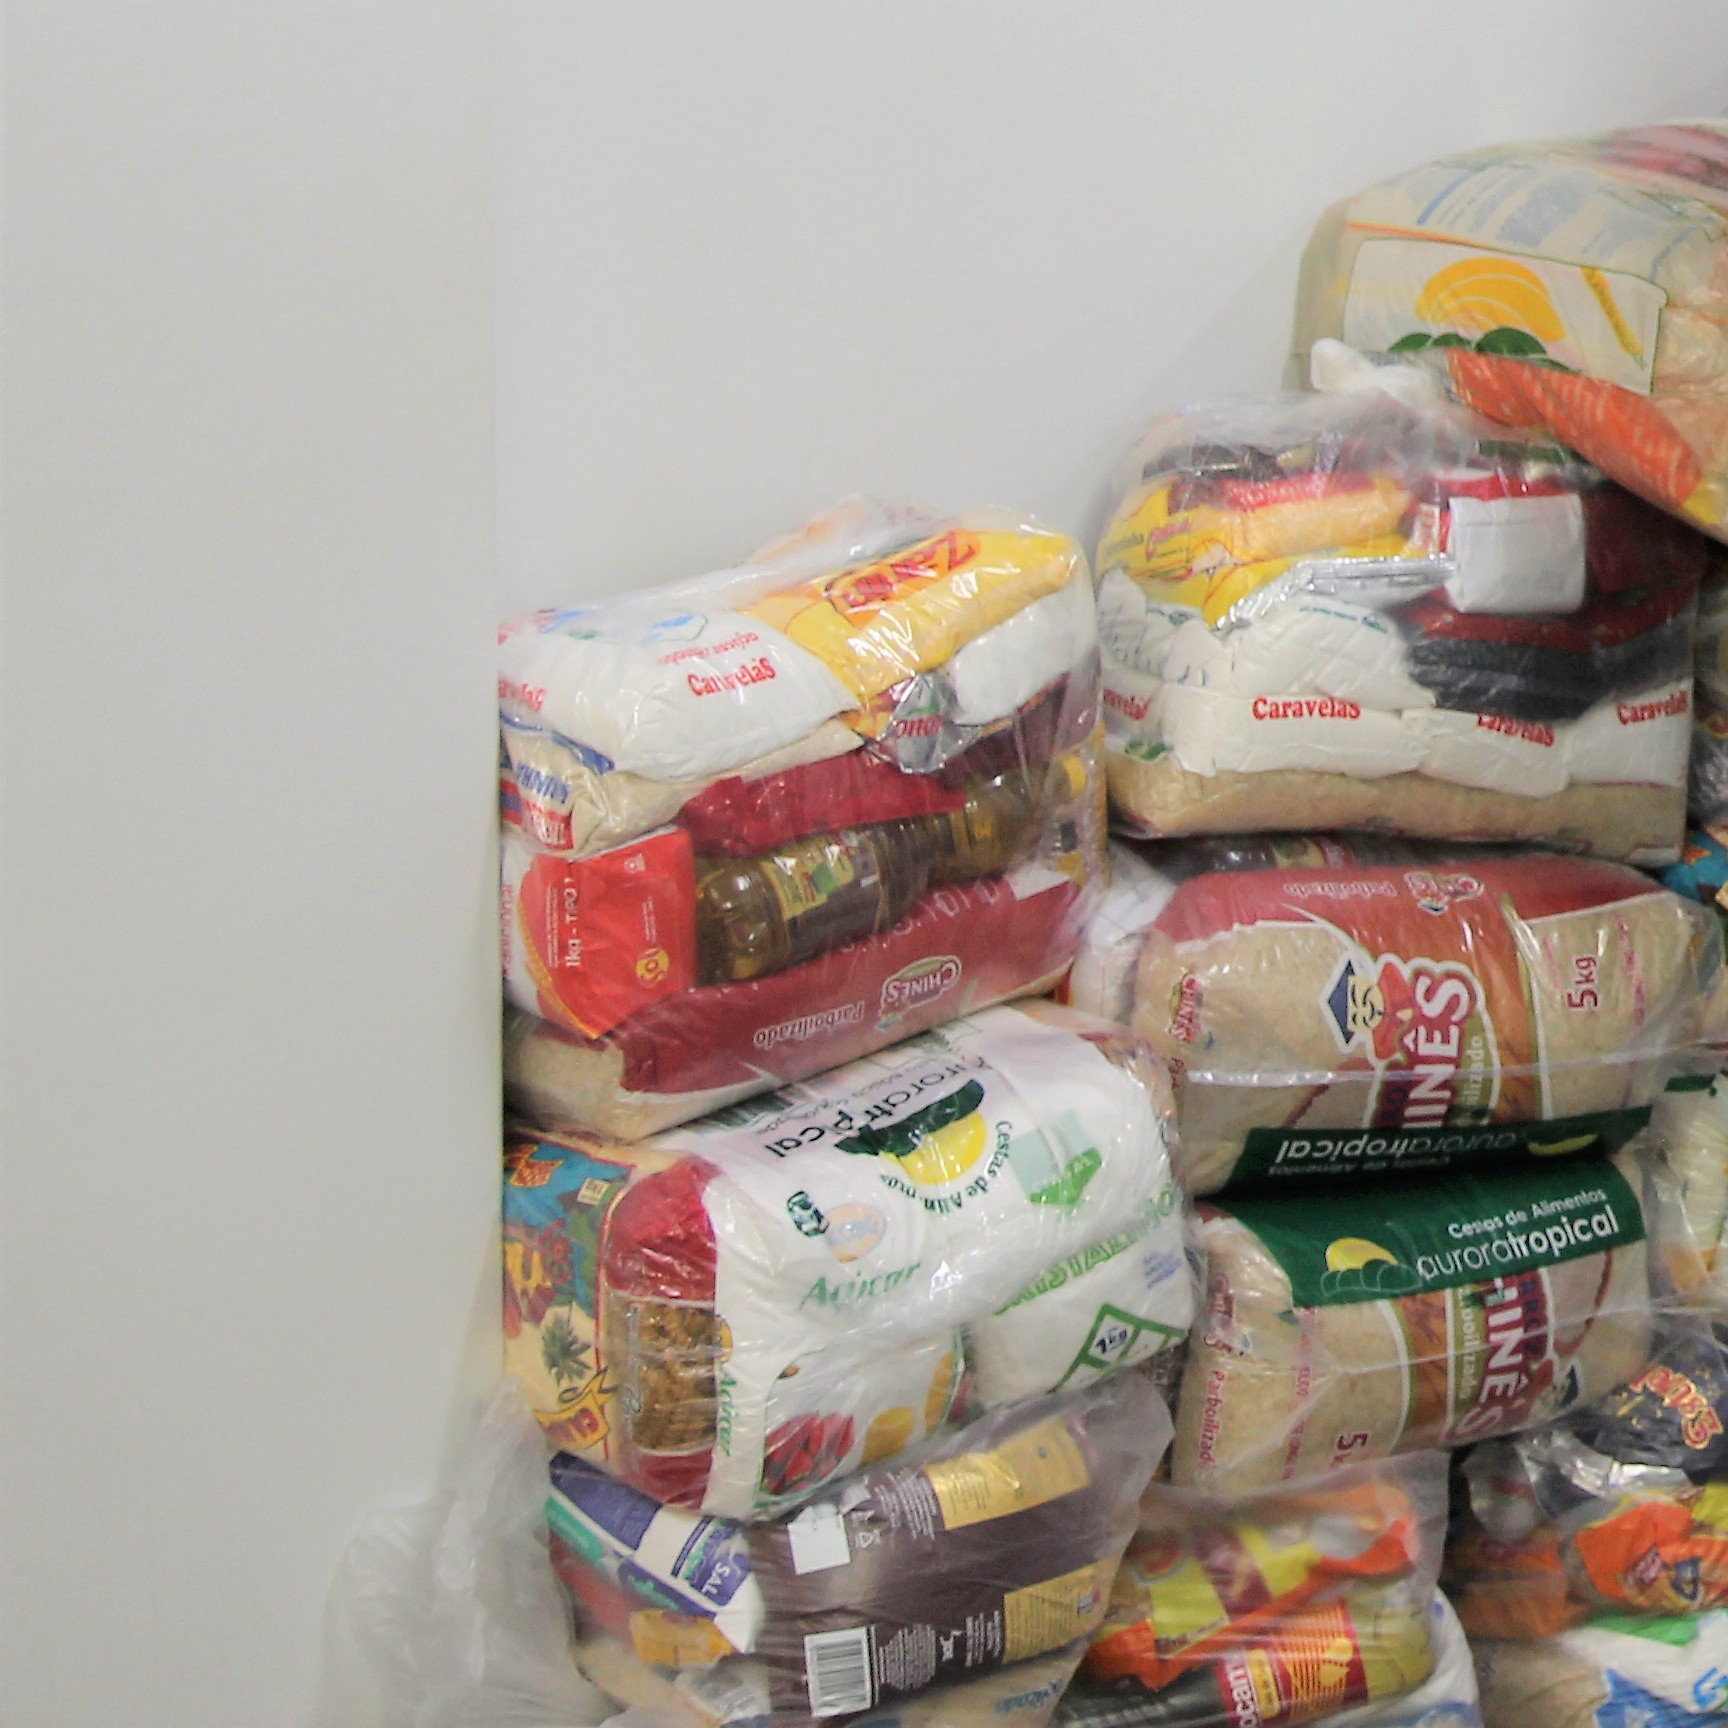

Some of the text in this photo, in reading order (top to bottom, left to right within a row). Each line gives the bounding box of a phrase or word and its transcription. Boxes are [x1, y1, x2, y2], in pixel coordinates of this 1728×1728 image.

[1251, 696, 1362, 723] Caravelas
[1566, 955, 1599, 1010] 5kg
[1403, 974, 1470, 1129] INÊS
[1274, 1129, 1518, 1165] auroratropical
[1504, 1208, 1528, 1227] de
[1531, 1188, 1608, 1219] Alimentos
[1416, 1204, 1620, 1281] auroratropical
[1457, 1276, 1530, 1430] HINÊS
[701, 1561, 731, 1597] SAL
